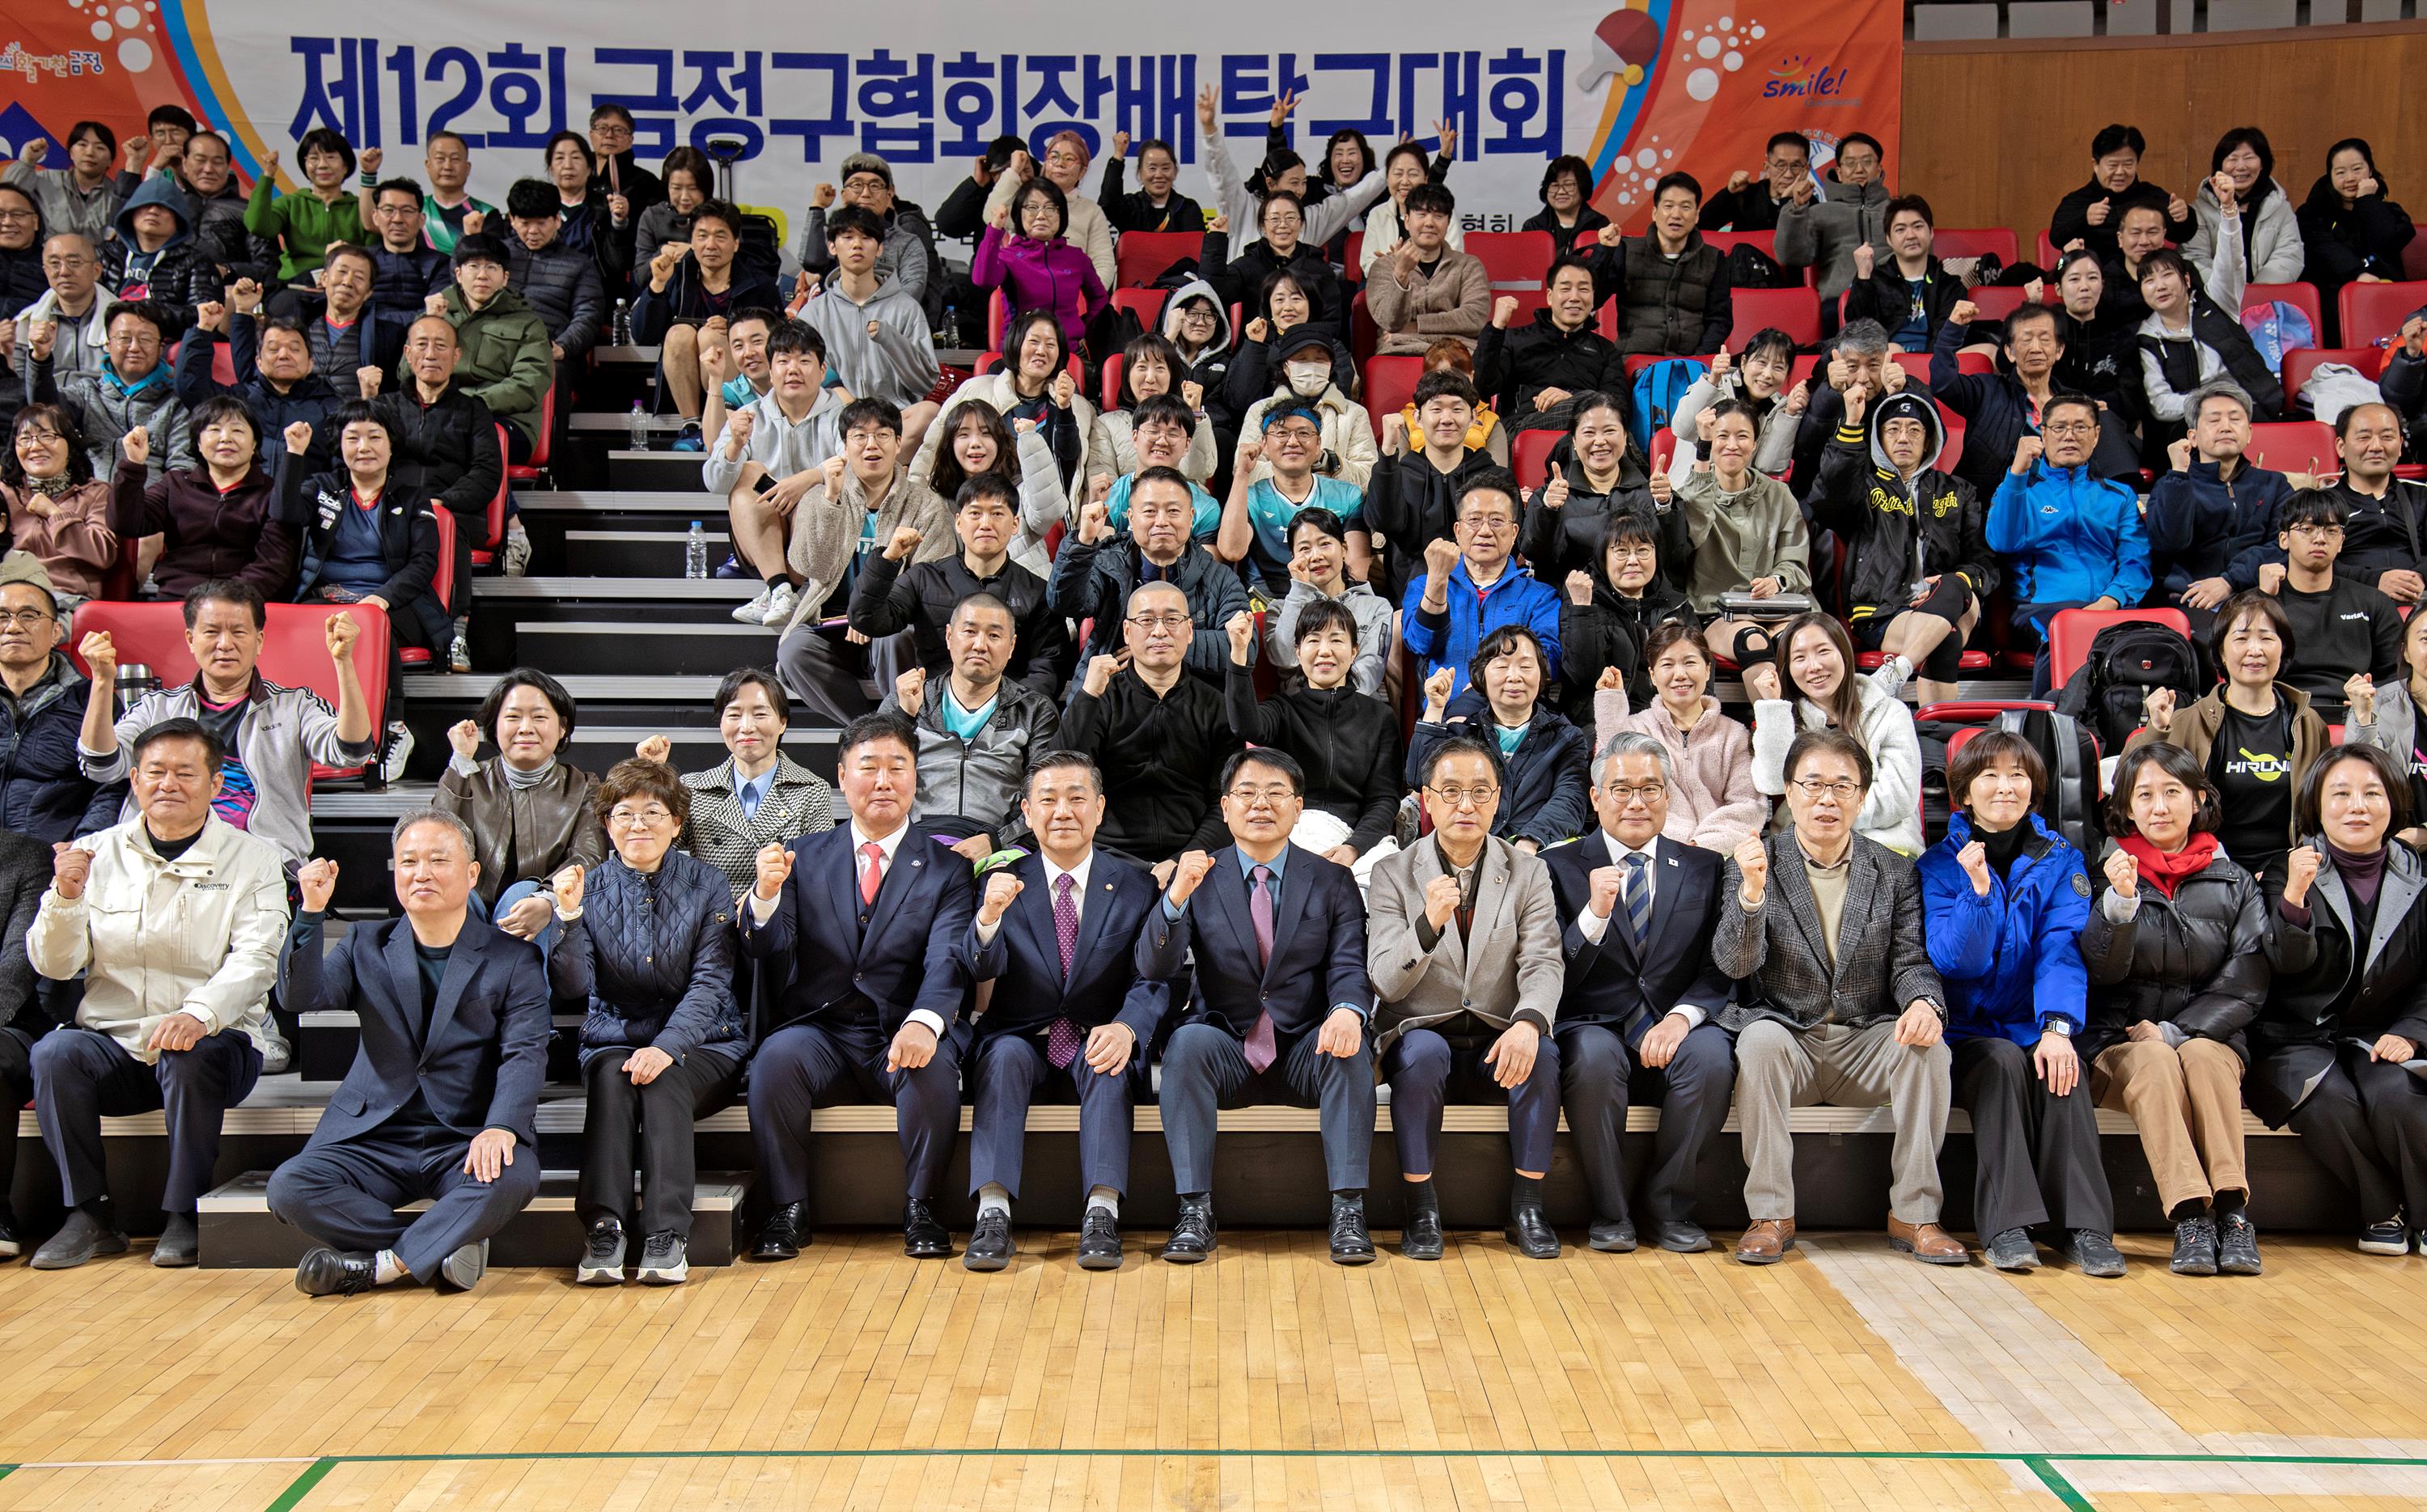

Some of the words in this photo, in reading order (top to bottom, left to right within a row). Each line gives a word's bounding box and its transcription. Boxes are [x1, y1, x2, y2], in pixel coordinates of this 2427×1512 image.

[16, 50, 68, 83] 활기찬
[70, 50, 104, 75] 금정
[288, 36, 568, 150] 제12회
[591, 47, 1197, 164] 금정구협회장배
[1221, 47, 1566, 162] 탁구대회
